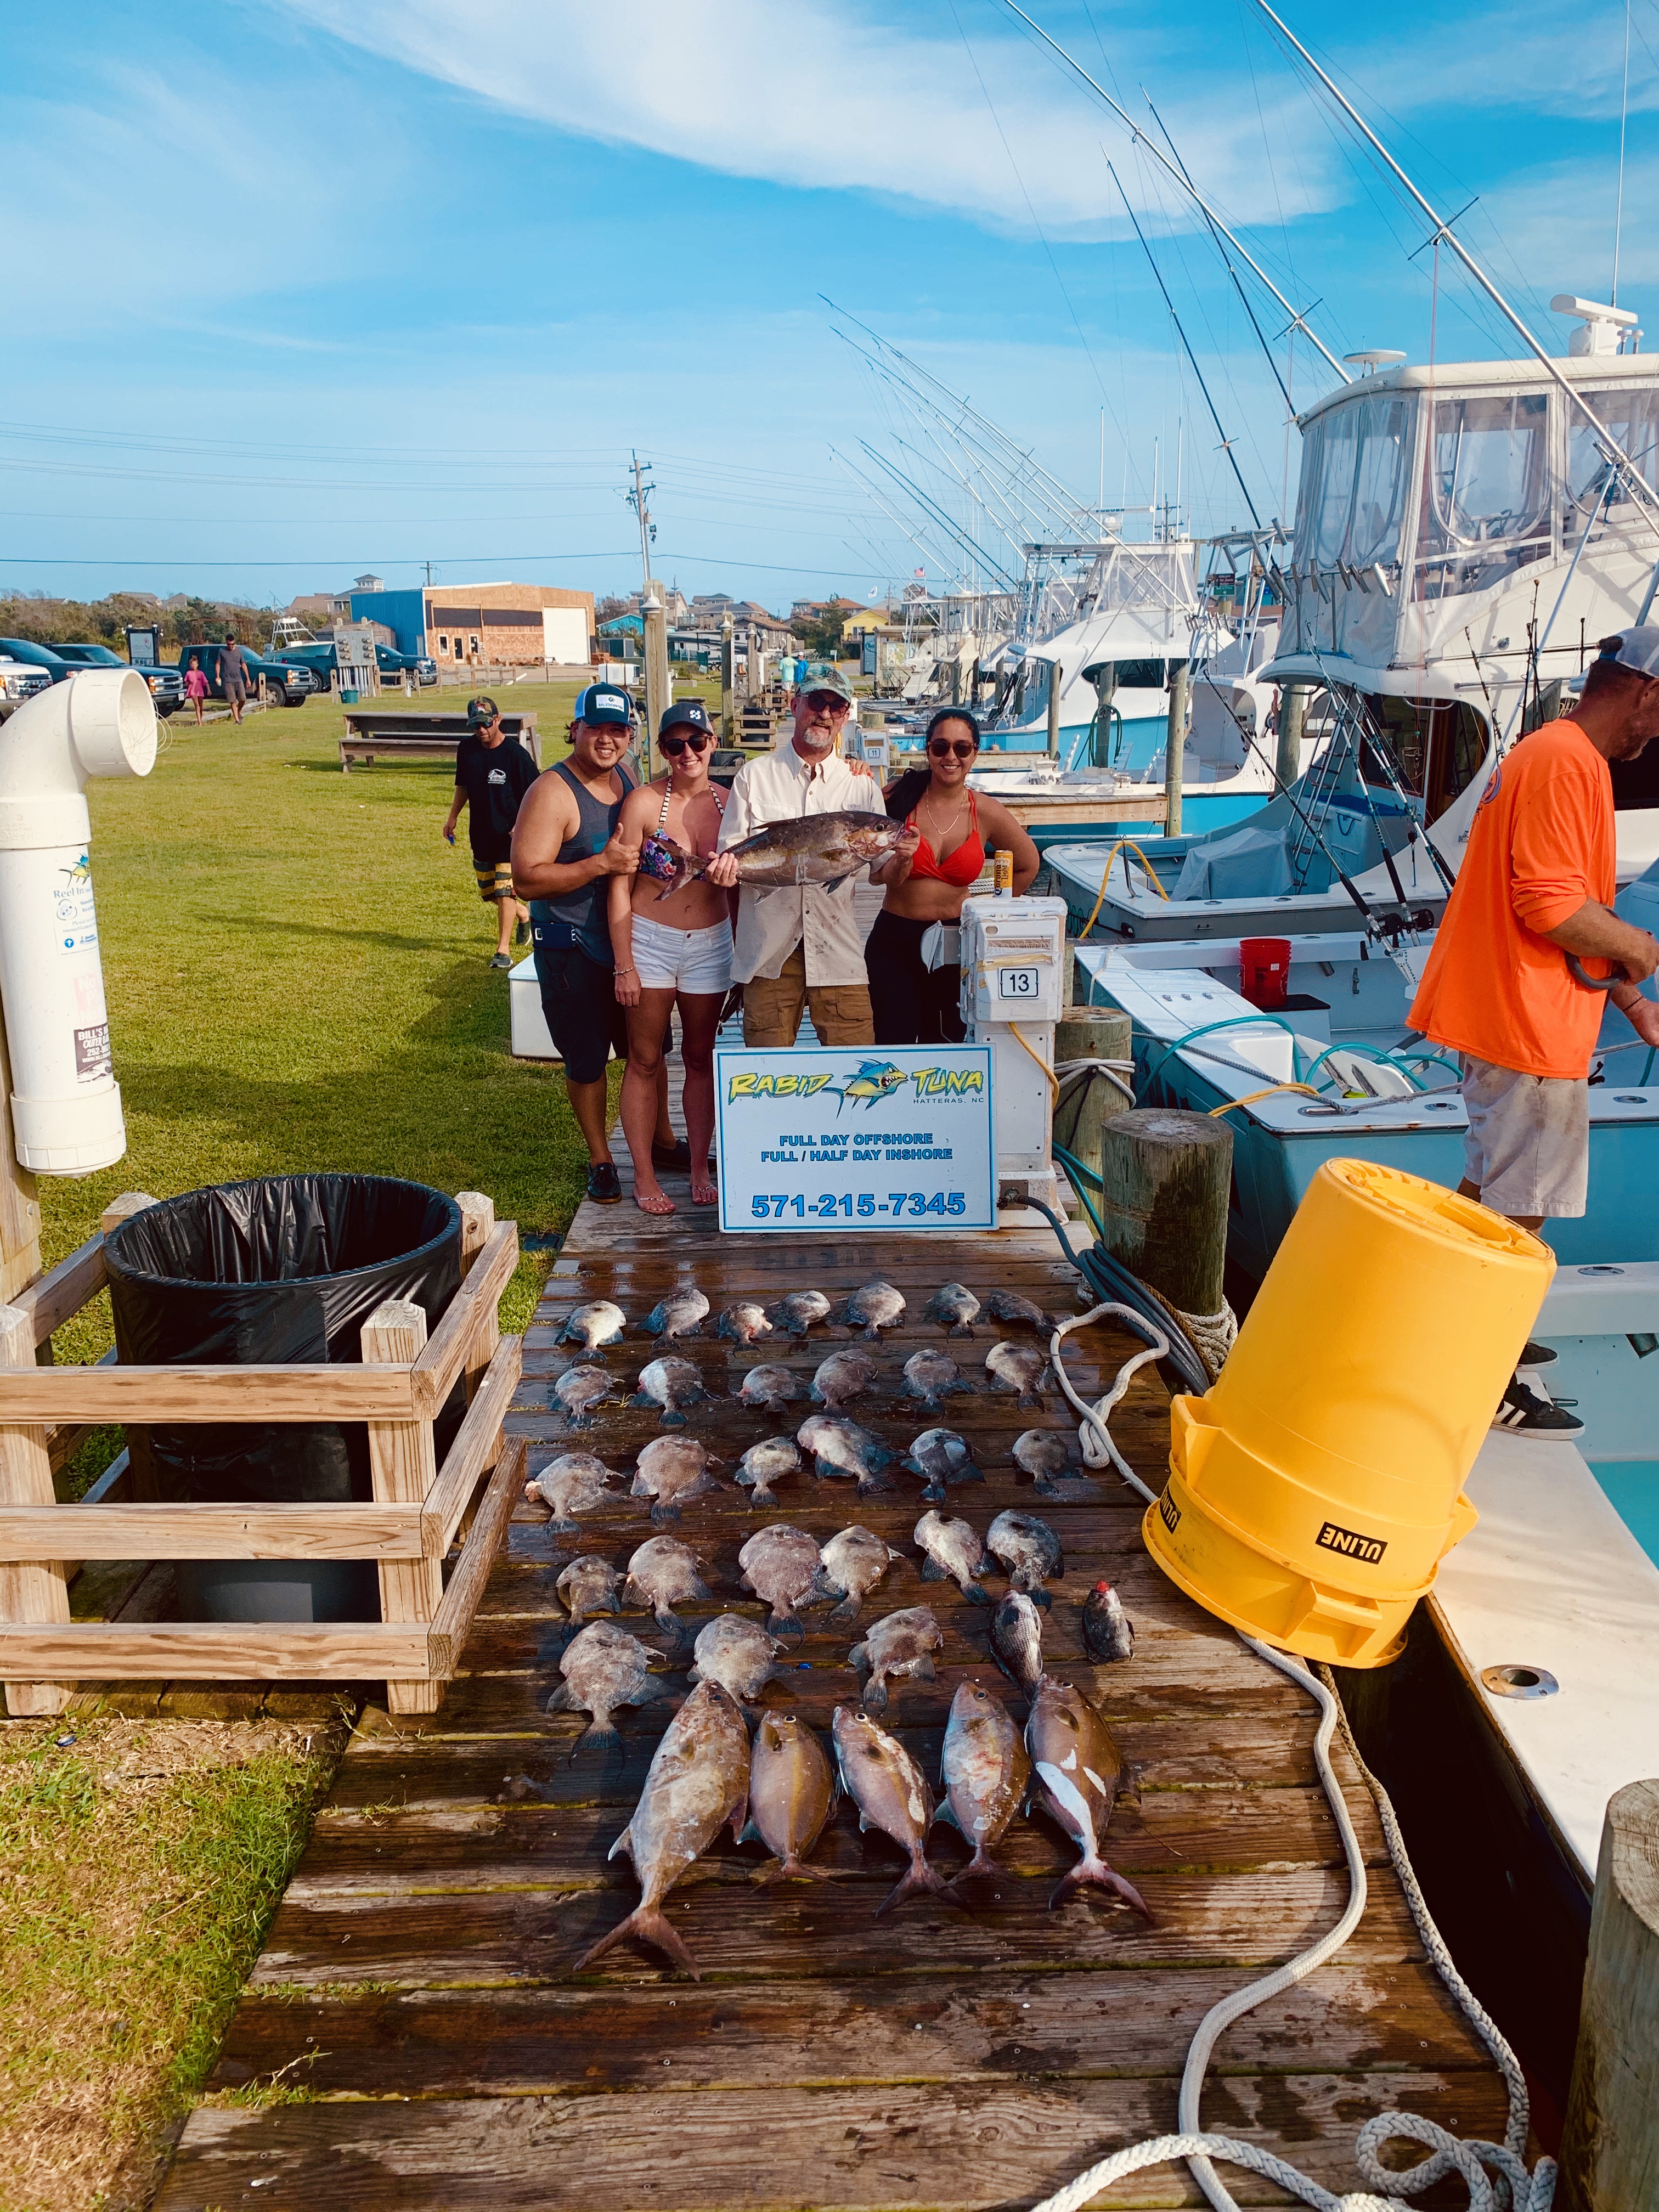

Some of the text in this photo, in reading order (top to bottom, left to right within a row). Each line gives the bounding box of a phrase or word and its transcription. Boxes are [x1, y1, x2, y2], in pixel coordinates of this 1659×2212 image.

[53, 887, 74, 898] Reel
[1009, 974, 1029, 992] 13
[78, 1028, 103, 1041] BILL'S
[83, 1037, 103, 1048] OUTER
[728, 1067, 984, 1105] RABID TUNA
[780, 1133, 933, 1147] FULL DAY OFFSHORE
[761, 1148, 953, 1162] FULL / HALF DAY INSHORE
[751, 1192, 966, 1218] 571-215-7345
[1321, 1527, 1381, 1560] ULINE
